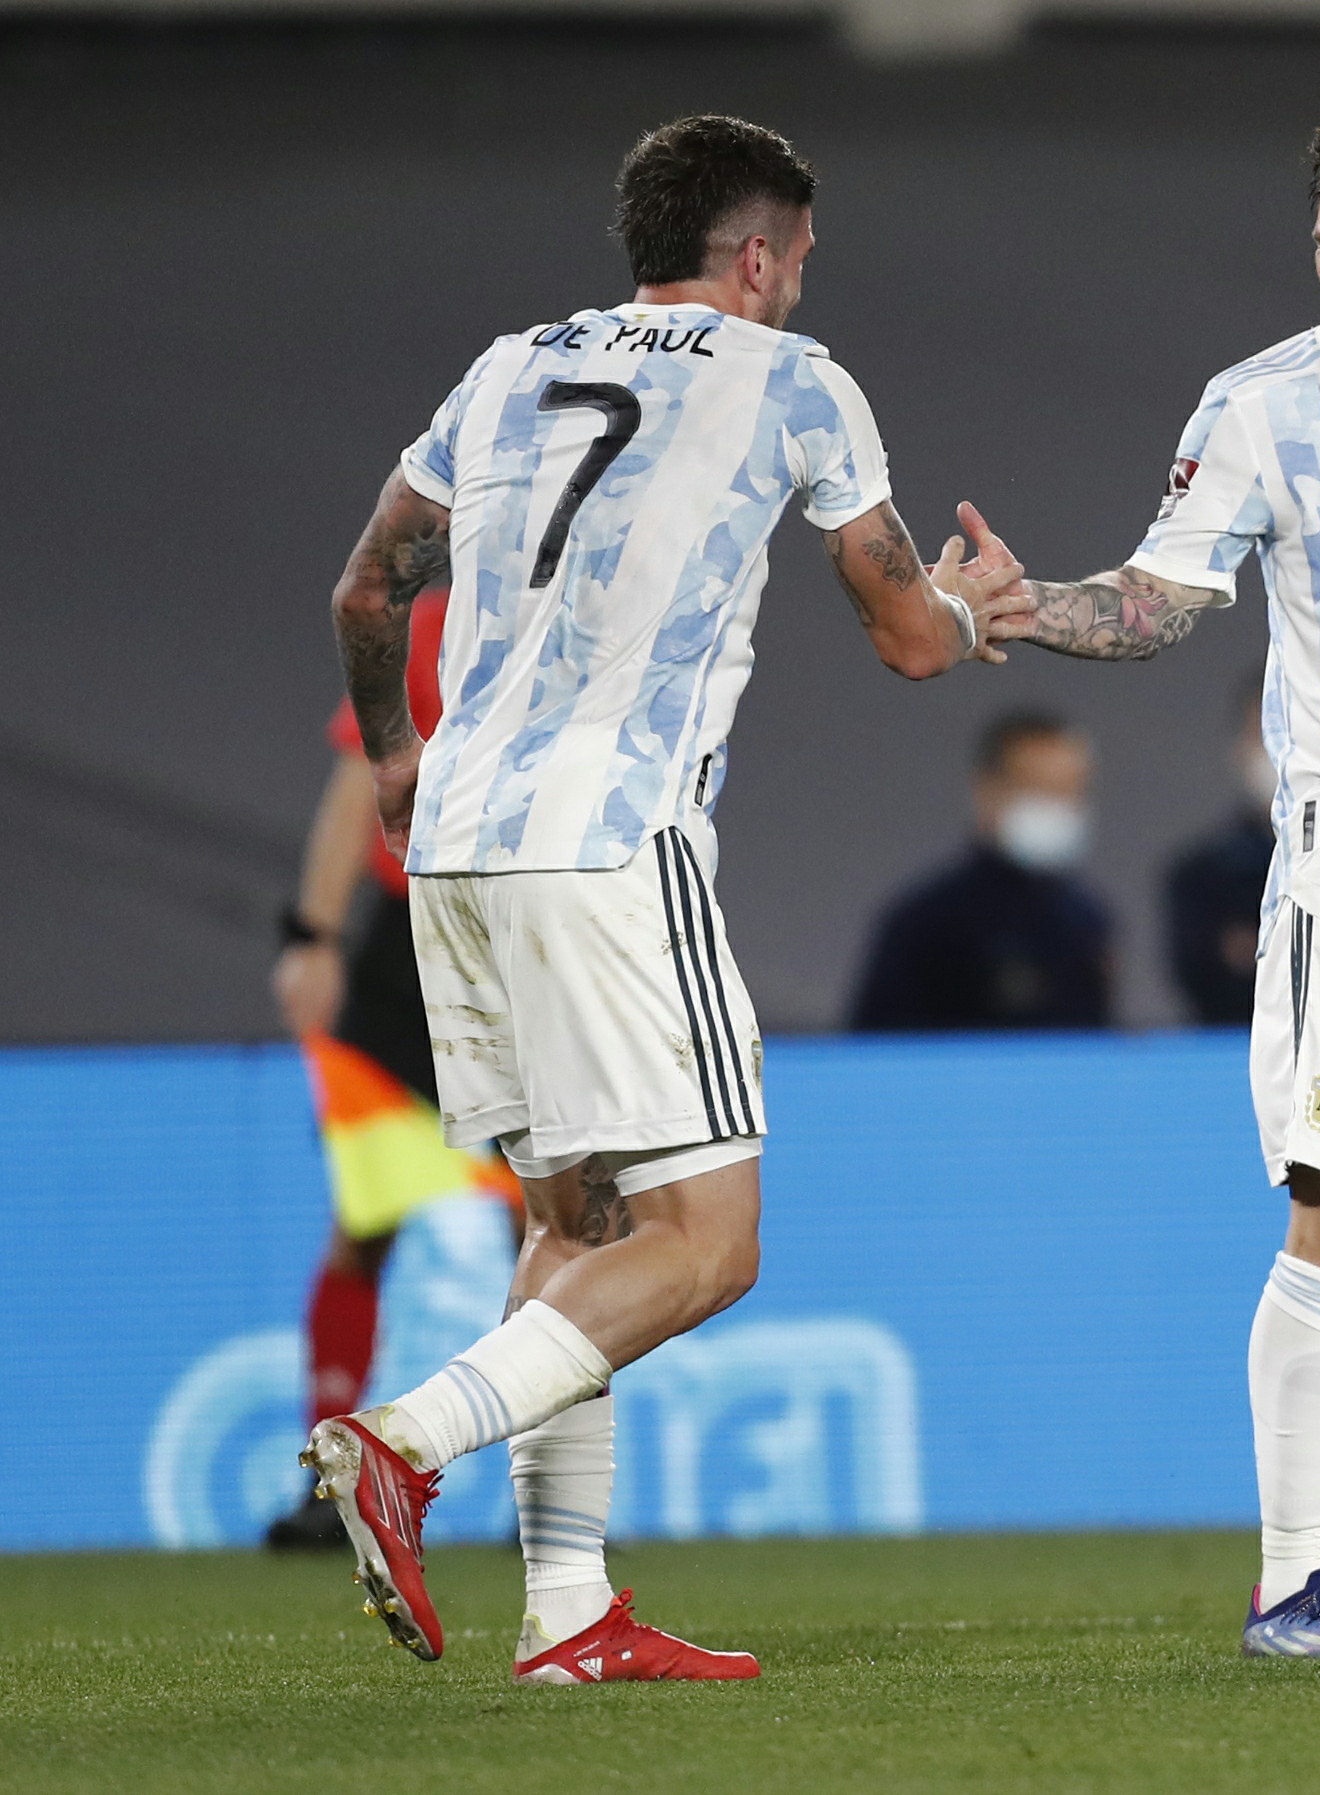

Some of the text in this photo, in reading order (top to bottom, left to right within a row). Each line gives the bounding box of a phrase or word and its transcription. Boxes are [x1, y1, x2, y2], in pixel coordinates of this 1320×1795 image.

[530, 322, 714, 358] DE PAUL
[529, 379, 642, 589] 7
[577, 1660, 603, 1681] adidas
